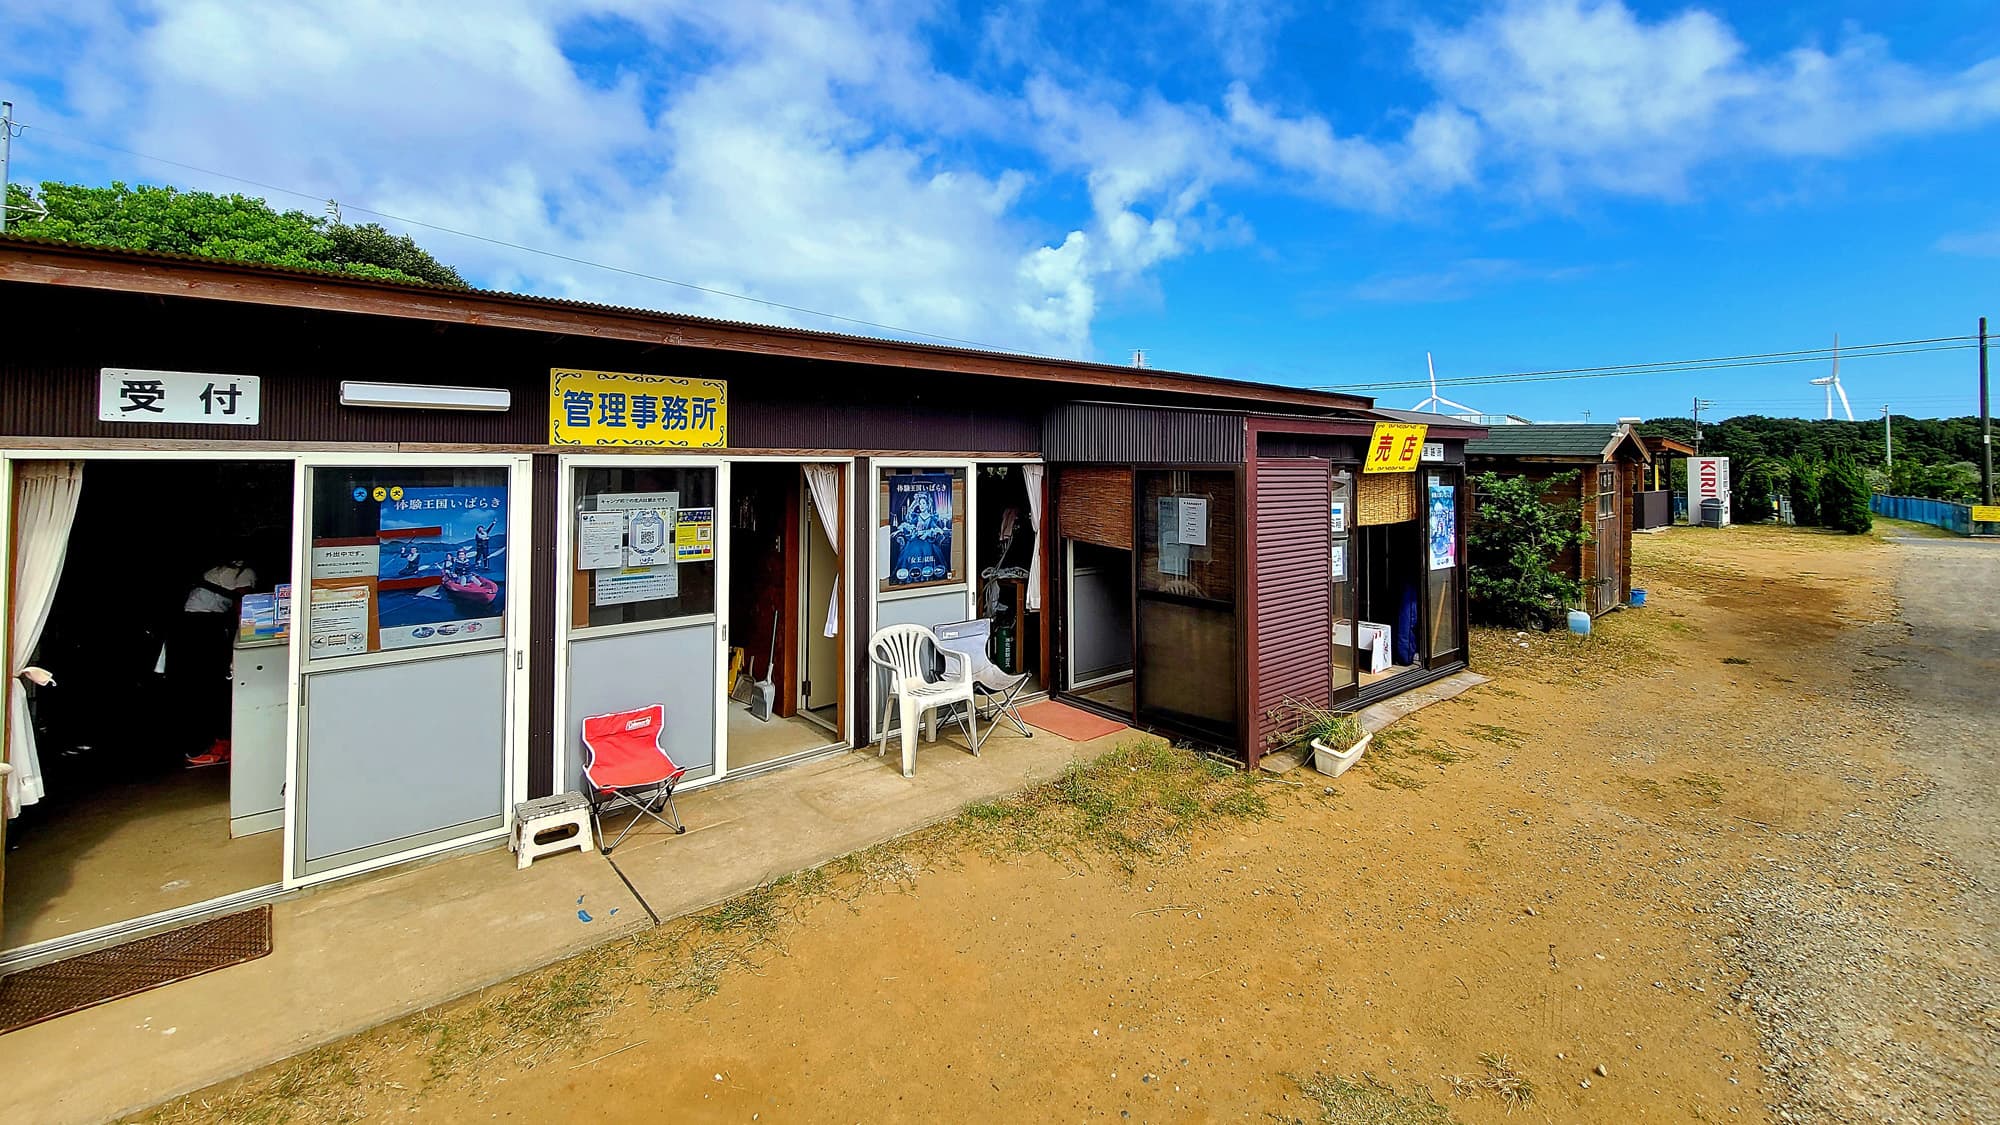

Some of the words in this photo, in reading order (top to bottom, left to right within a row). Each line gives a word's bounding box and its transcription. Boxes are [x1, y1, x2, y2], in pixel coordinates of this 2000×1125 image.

[119, 380, 242, 415] 受付
[563, 389, 717, 431] 管理事務所
[1374, 433, 1418, 462] 売店
[1700, 460, 1716, 497] KIRI
[395, 497, 501, 511] 体験王国いばらき
